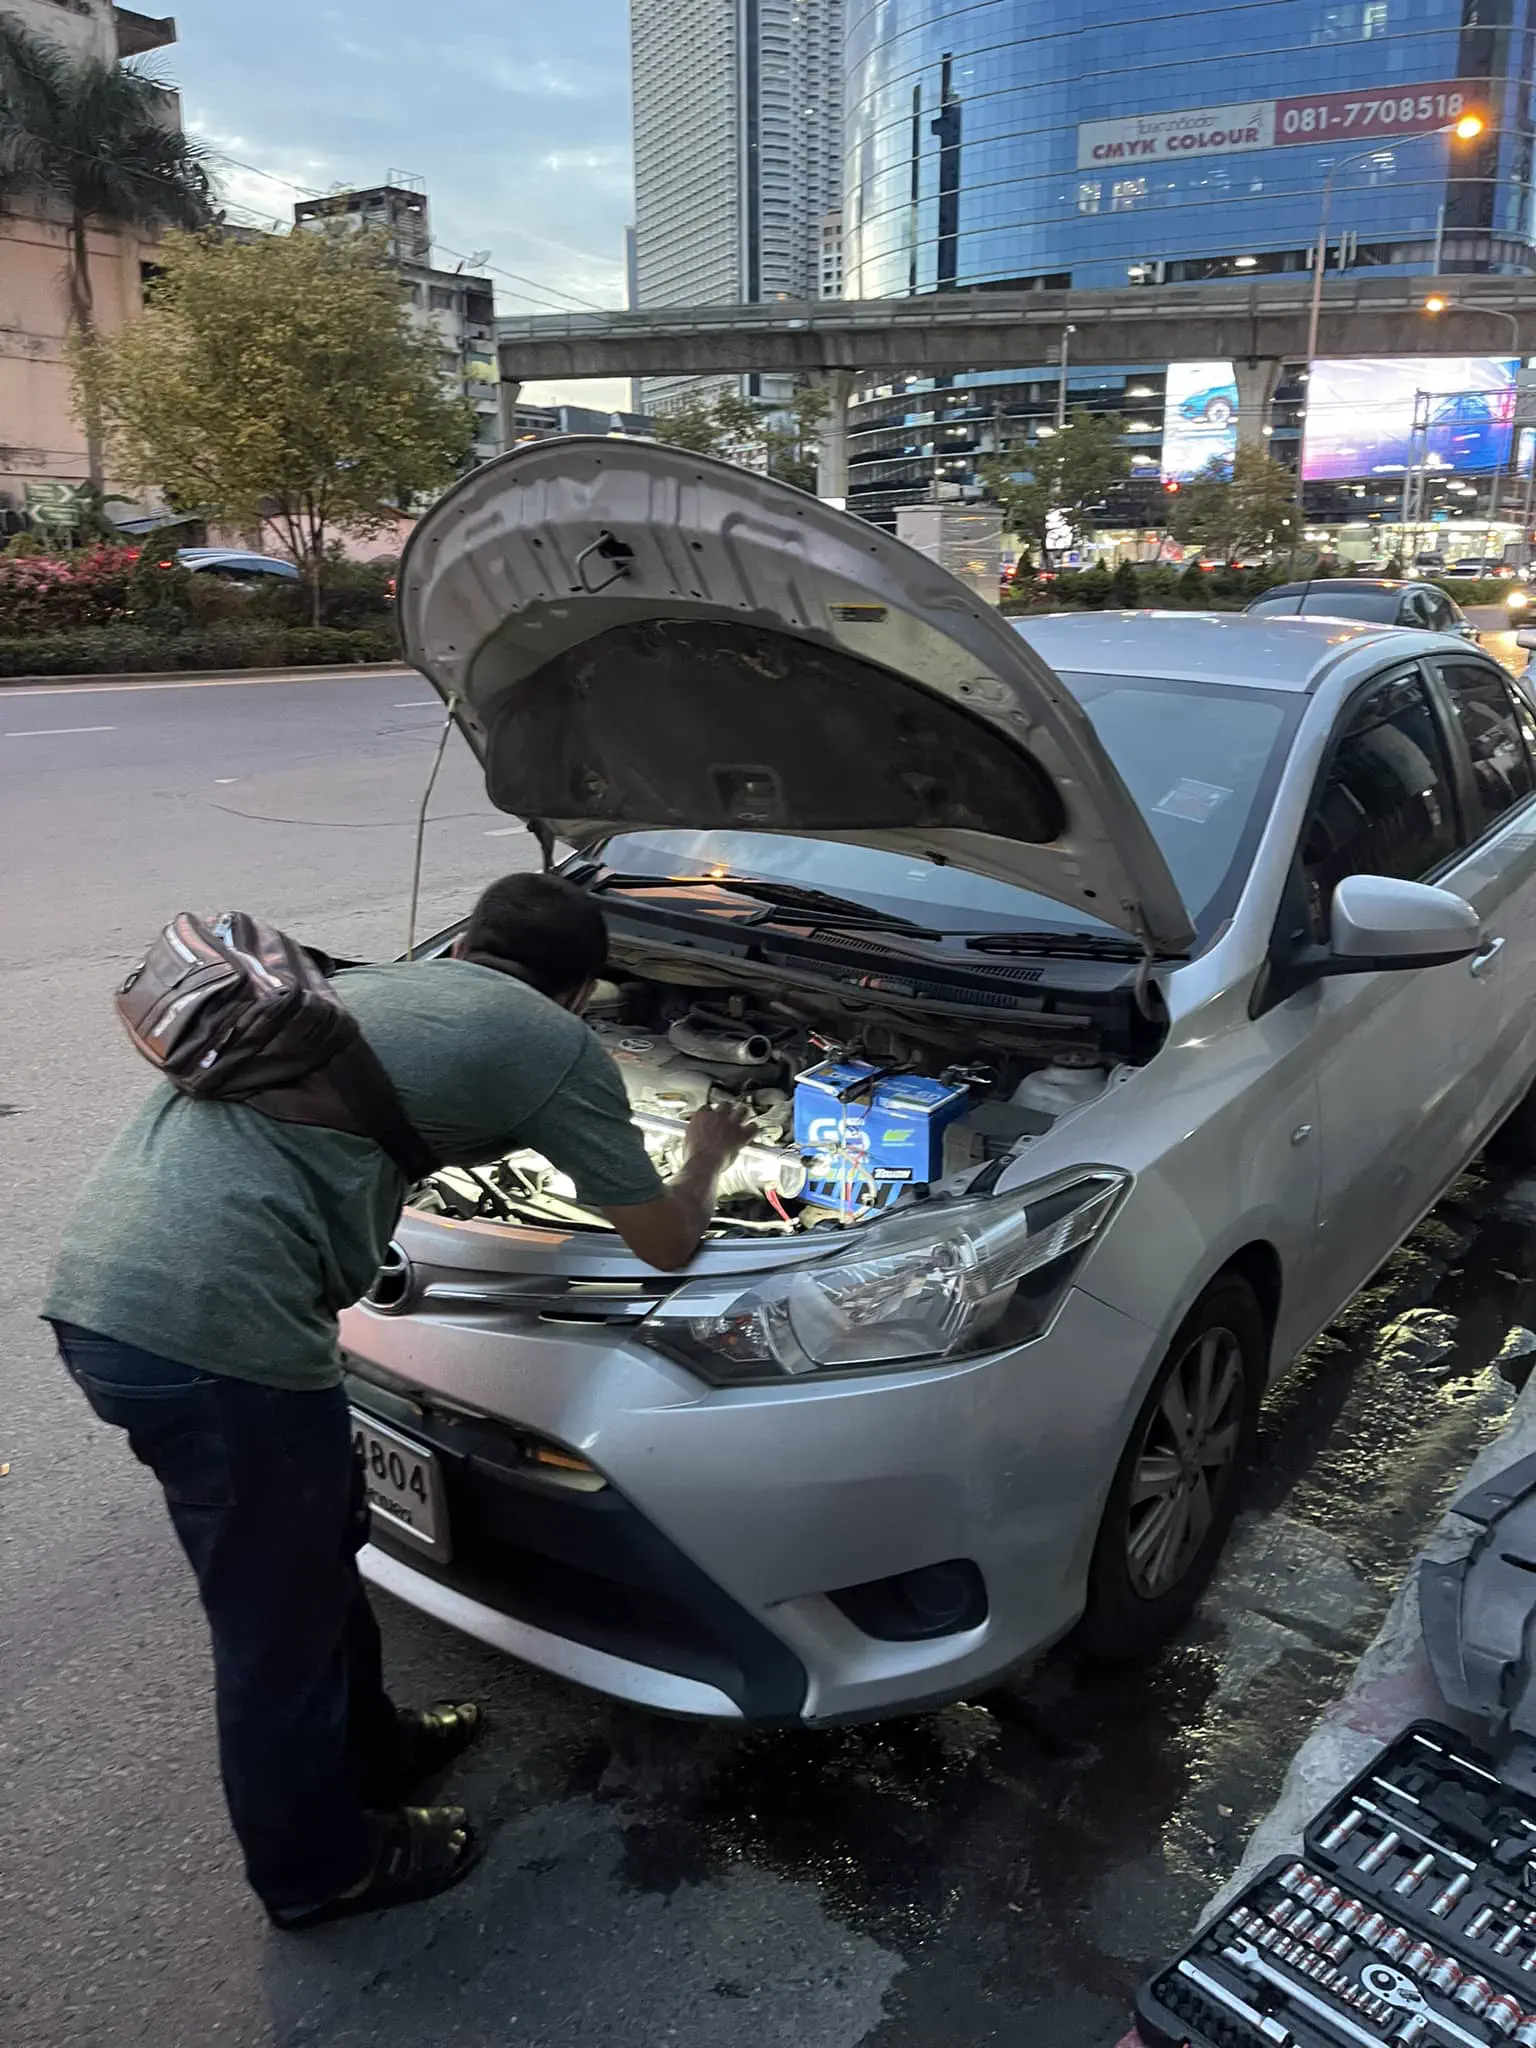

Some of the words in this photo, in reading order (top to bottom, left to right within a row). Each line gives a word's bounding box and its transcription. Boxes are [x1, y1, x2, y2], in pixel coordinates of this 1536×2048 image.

[1283, 93, 1464, 134] 081-7708518
[1092, 138, 1157, 160] CMYK
[1165, 127, 1259, 151] COLOUR
